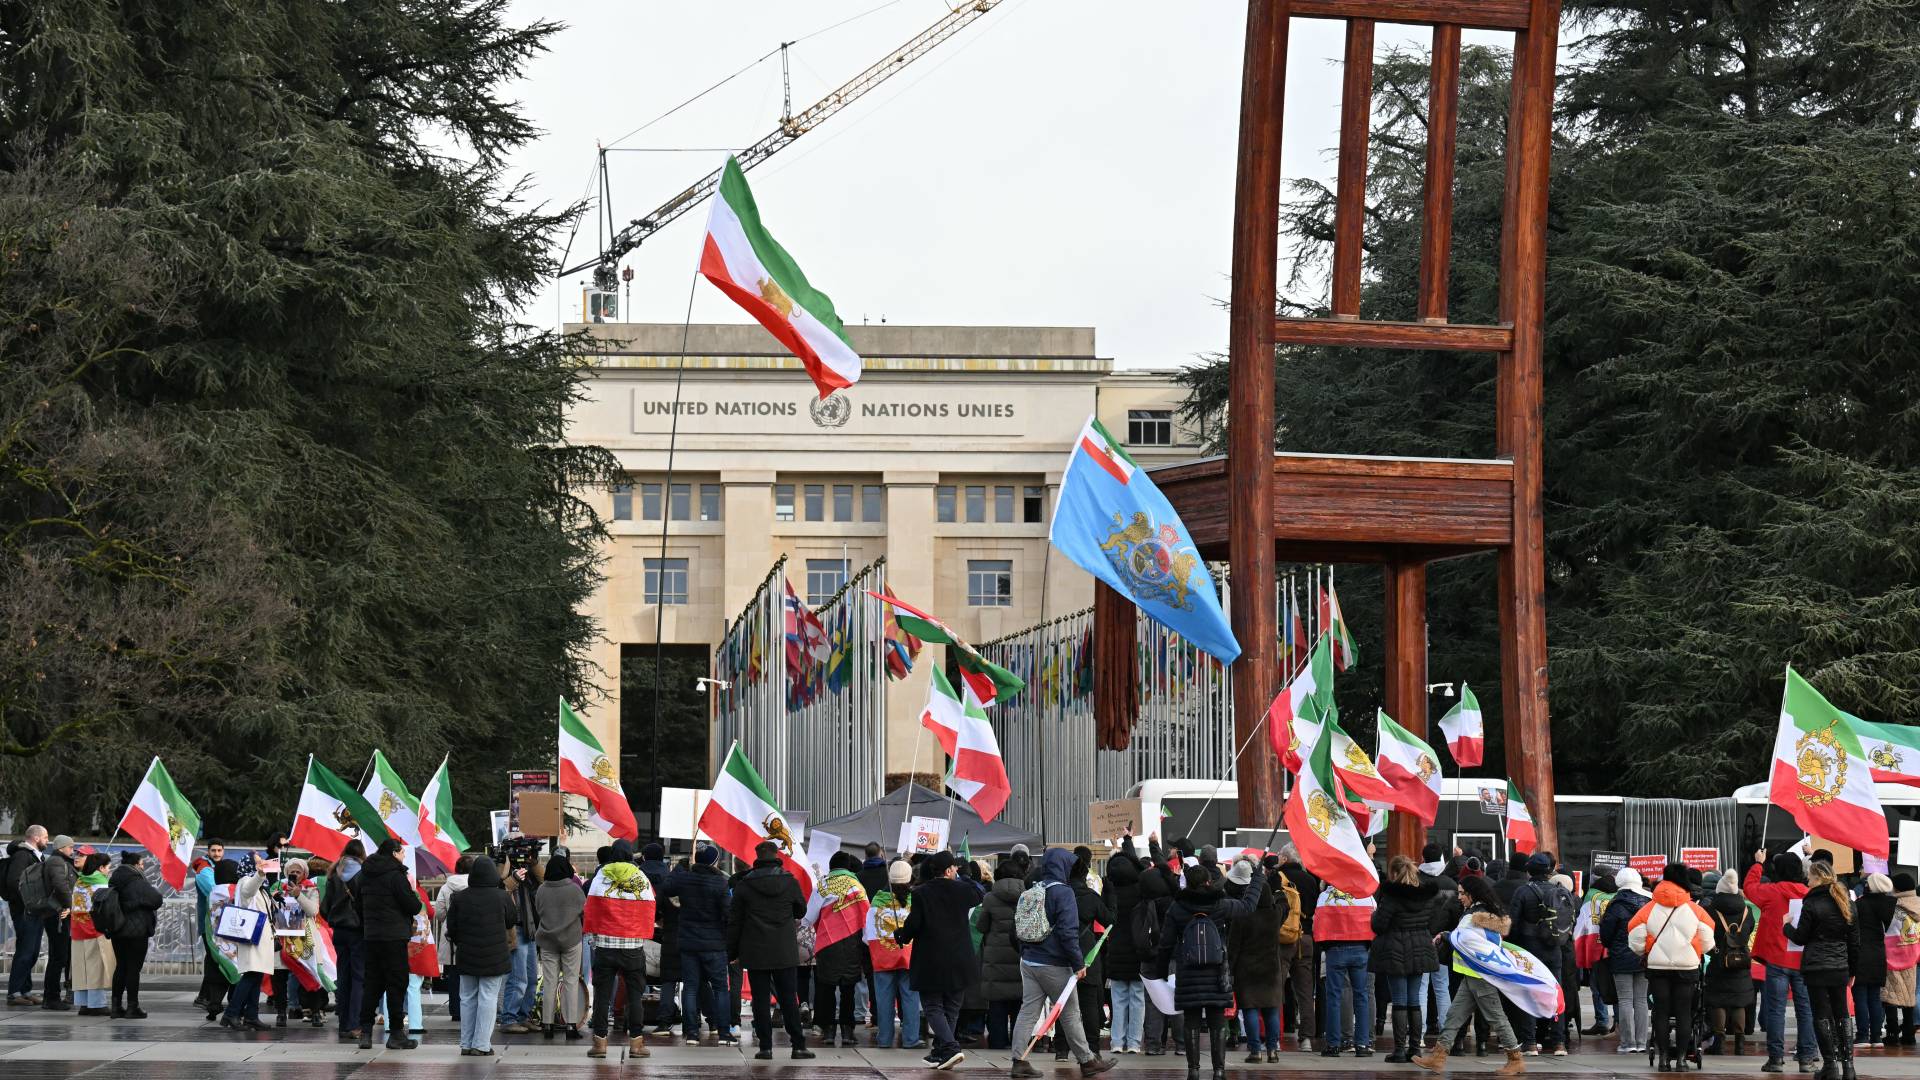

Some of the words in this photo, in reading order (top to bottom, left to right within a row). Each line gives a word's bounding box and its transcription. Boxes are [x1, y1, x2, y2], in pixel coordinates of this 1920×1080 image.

[643, 401, 708, 416] UNITED
[715, 402, 797, 417] NATIONS
[862, 403, 949, 418] NATIONS
[957, 404, 1015, 419] UNIES
